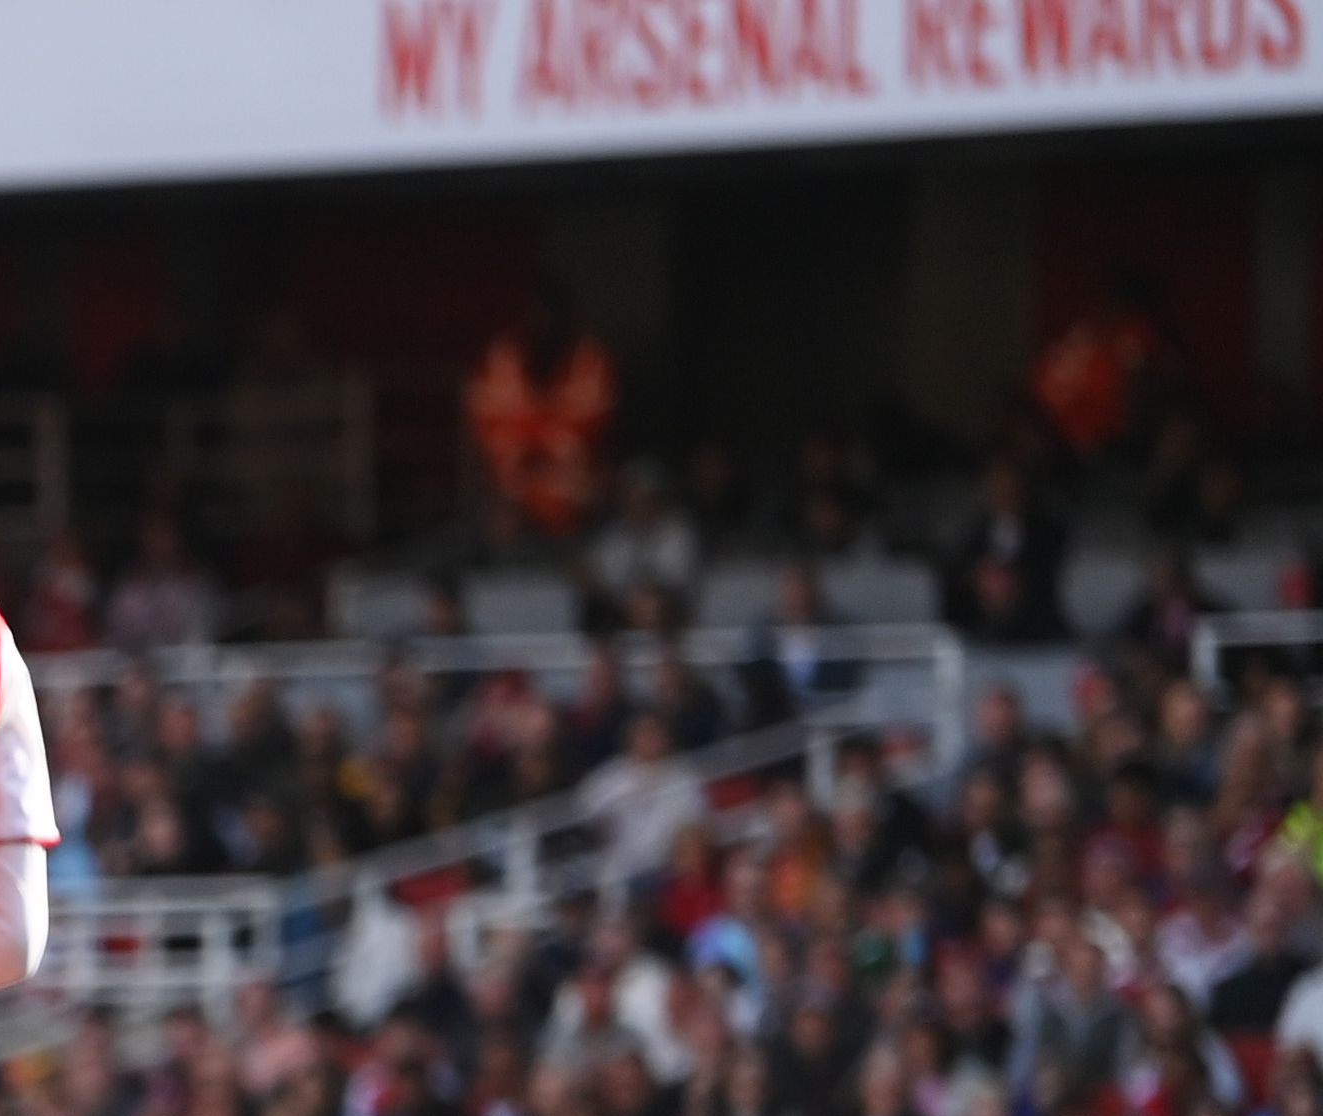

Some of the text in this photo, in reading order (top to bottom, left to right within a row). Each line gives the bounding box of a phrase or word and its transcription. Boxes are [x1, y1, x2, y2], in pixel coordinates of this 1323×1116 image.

[375, 0, 1305, 122] MY ARSENAL REWARDS
